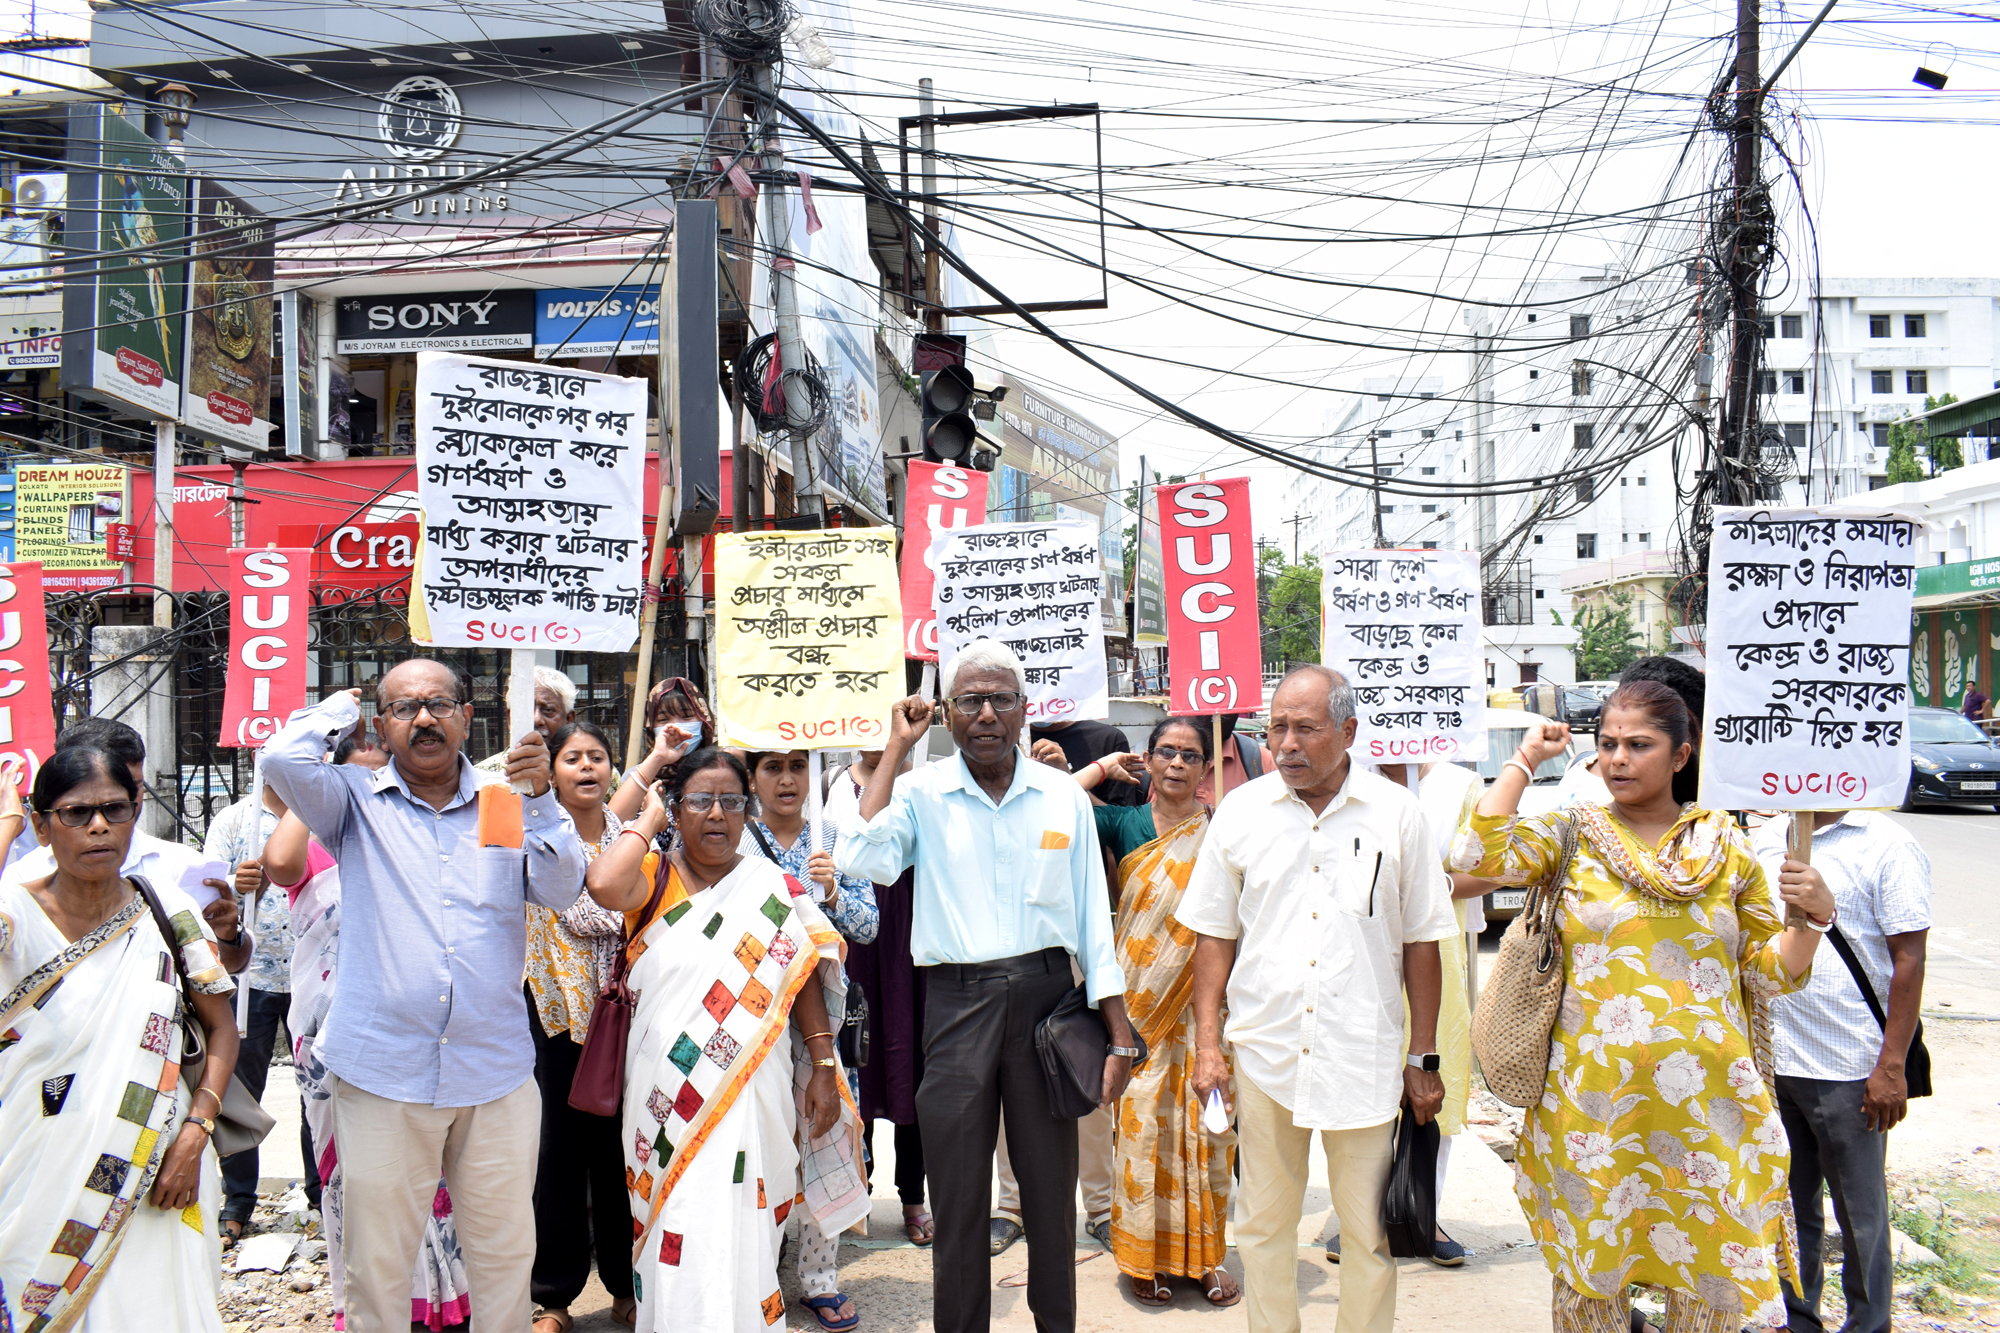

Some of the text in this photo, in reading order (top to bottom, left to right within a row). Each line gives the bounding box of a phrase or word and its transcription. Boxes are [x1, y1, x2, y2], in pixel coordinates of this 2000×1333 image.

[412, 195, 508, 215] DINING
[368, 301, 498, 331] SONY
[546, 299, 624, 319] VOLTAS
[20, 337, 62, 355] INFO
[344, 336, 524, 351] M/S JOYRAM ELECTRONICS & ELECTRICAL
[118, 351, 136, 368] Shyam
[136, 359, 154, 376] Sundar
[467, 364, 601, 400] রাজস্থানে
[208, 394, 252, 418] Shyam Sundar Co.
[221, 410, 239, 421] Jewellers
[595, 411, 635, 436] পর
[1024, 393, 1066, 431] FURNITURE
[1065, 417, 1101, 450] SHOWROOM
[569, 440, 629, 468] করে
[19, 468, 122, 482] DREAM HOUZZ
[427, 458, 567, 491] গণধর্ষণ ও
[1031, 444, 1107, 504] ARANYAK
[23, 505, 68, 513] CURTAINS
[24, 491, 94, 502] WALLPAPERS
[23, 516, 63, 524] BLINDS
[452, 494, 613, 525] আত্মহত্যায়
[23, 527, 63, 535] PANELS
[23, 538, 66, 546] FLOORINGS
[427, 518, 638, 563] বাধ্য করার ঘটনার
[958, 529, 1057, 551] রাজস্থানে
[1723, 511, 1841, 552] মহিলাদের
[22, 549, 68, 557] CUSTOMIZED
[854, 538, 892, 558] সহ
[42, 559, 91, 567] DECORATIONS
[441, 557, 604, 588] অপরাধীদের
[773, 563, 853, 581] সকল
[941, 555, 1028, 580] দুইবোনের
[1061, 543, 1097, 564] ধর্ষণ
[1333, 557, 1438, 583] সারা দেশে
[1724, 562, 1790, 591] রক্ষা
[1795, 558, 1815, 587] ও
[1824, 550, 1915, 591] নিরাপত্তা
[1969, 563, 1984, 576] IGM
[602, 585, 639, 619] চাই
[731, 582, 876, 607] প্রচার মাধ্যমে
[939, 587, 954, 603] ও
[962, 581, 1057, 602] আত্মহত্যার
[1332, 586, 1474, 612] ধর্ষণ ও গণ ধর্ষণ
[731, 609, 888, 639] অশ্লীল প্রচার
[946, 606, 1007, 633] পুলিশ
[1006, 601, 1095, 626] প্রশাসনের
[1763, 599, 1858, 634] প্রদানে
[1345, 624, 1463, 649] বাড়ছে কেন
[770, 644, 846, 666] বন্ধ
[1349, 655, 1429, 679] কেন্দ্র ও
[1728, 638, 1910, 676] কেন্দ্র ও রাজ্য
[737, 671, 888, 697] করতে হবে
[1394, 685, 1470, 706] সরকার
[1772, 679, 1906, 712] সরকারকে
[1369, 711, 1462, 730] জবাব দাও
[1714, 703, 1903, 749] গ্যারান্টি দিতে হবে
